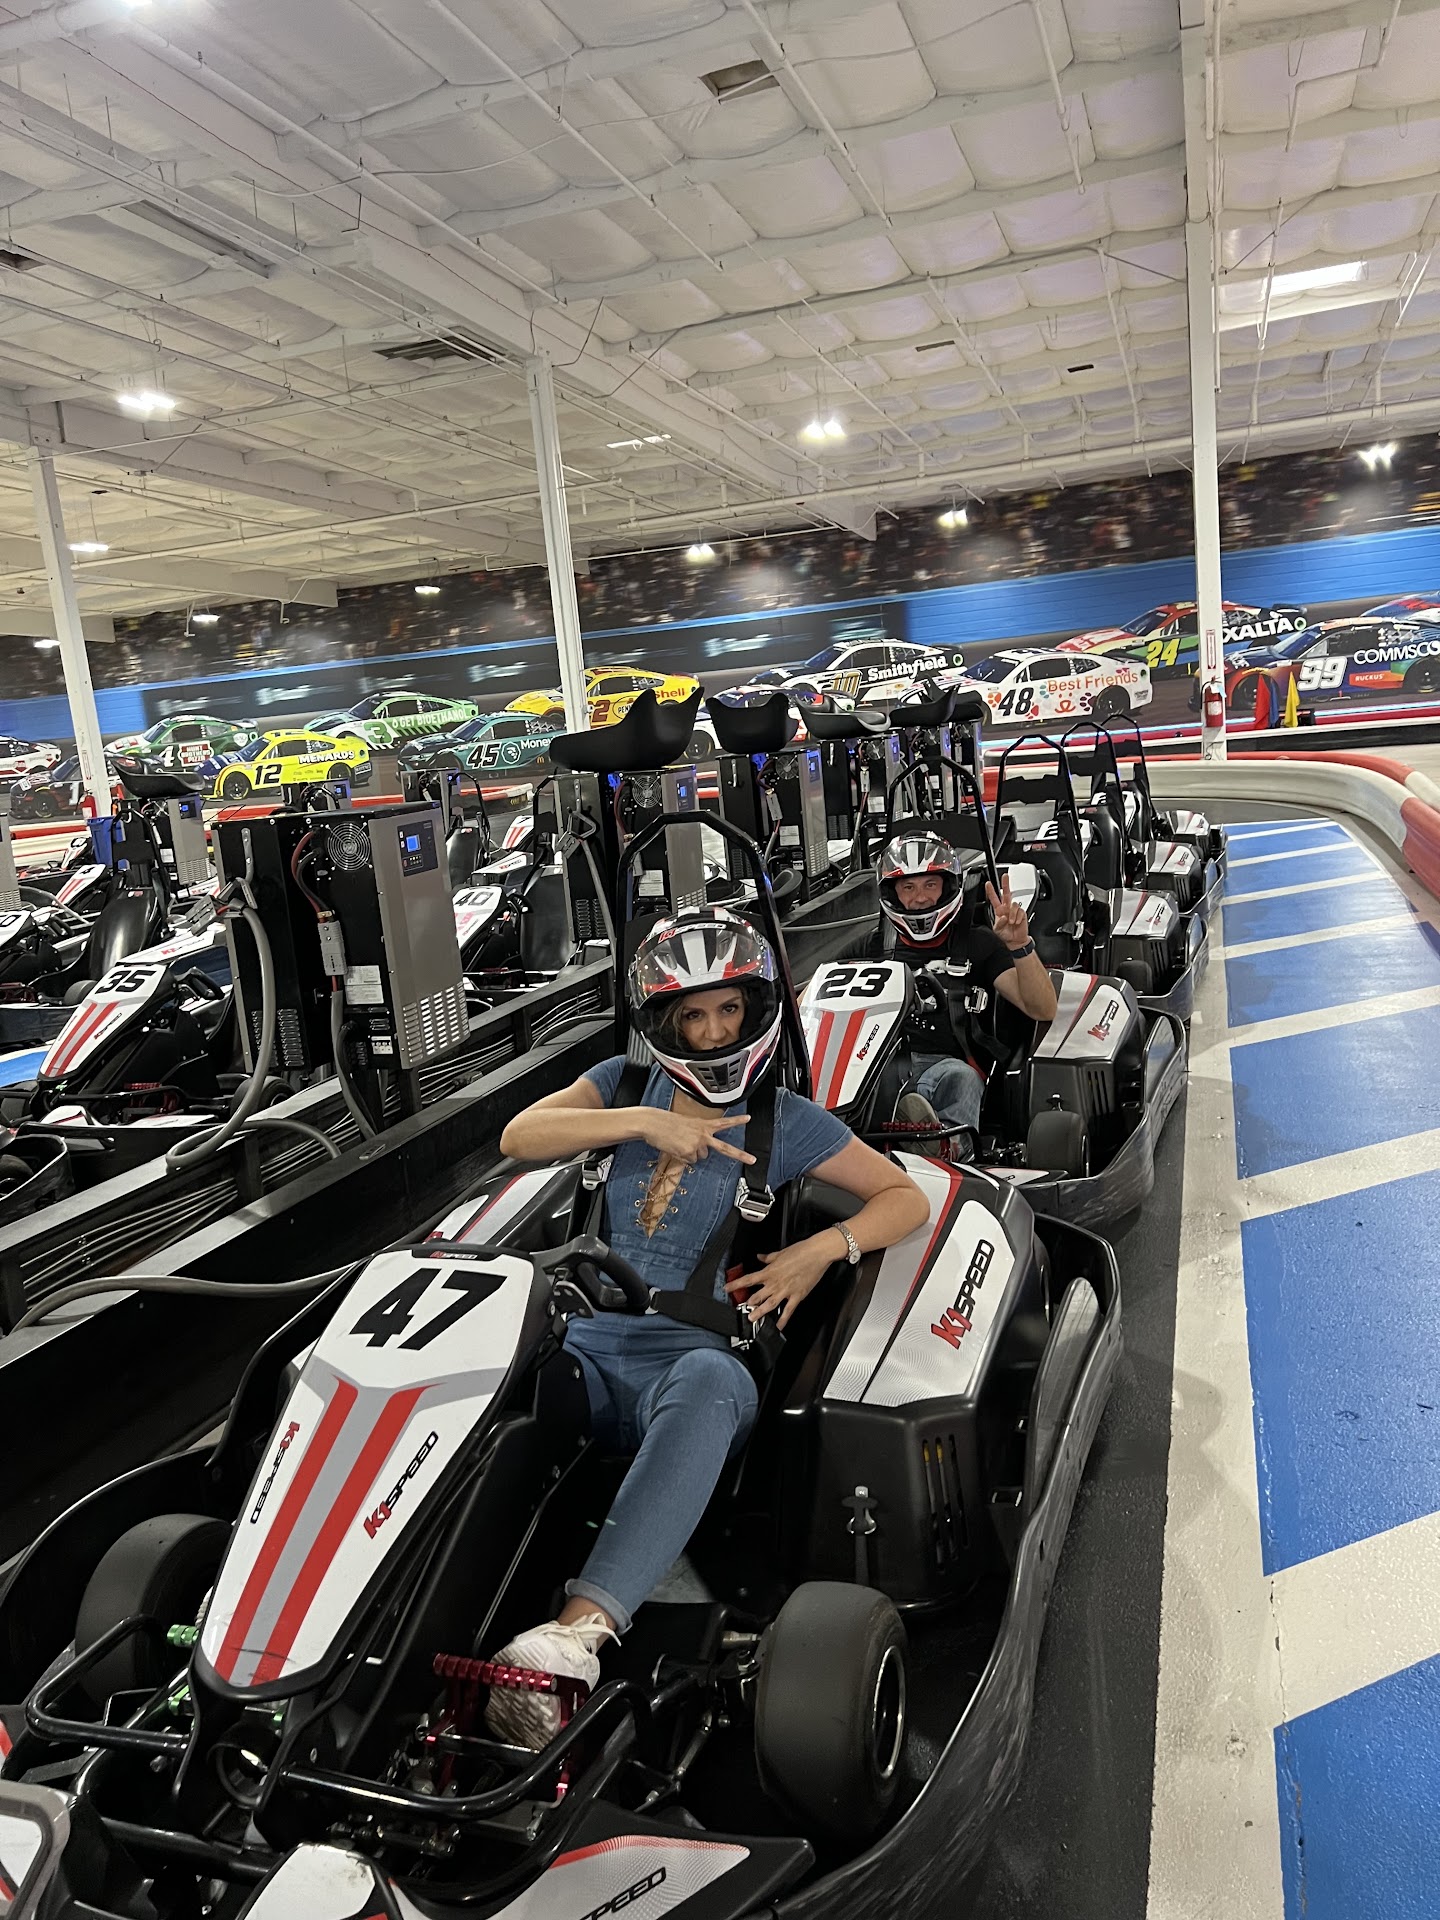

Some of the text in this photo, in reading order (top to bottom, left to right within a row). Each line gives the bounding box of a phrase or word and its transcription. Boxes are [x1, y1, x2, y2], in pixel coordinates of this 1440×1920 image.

[1222, 617, 1294, 643] XALTA
[1146, 639, 1180, 668] 24
[868, 655, 948, 682] Smithfield
[1048, 671, 1139, 692] Best Friends
[1297, 656, 1348, 691] 99
[655, 688, 685, 699] Shell
[998, 687, 1034, 716] 48
[400, 708, 470, 727] GET BIOETHANOL
[363, 721, 393, 744] 3
[159, 745, 175, 767] 4
[298, 750, 355, 764] MENARDS
[466, 741, 502, 769] 45
[255, 764, 282, 785] 12
[454, 891, 494, 907] 40
[94, 970, 157, 994] 35
[814, 968, 893, 1000] 23
[855, 1023, 880, 1061] K1SPEED
[931, 1239, 995, 1350] K1SPEED
[348, 1267, 508, 1351] 47
[363, 1431, 439, 1539] K1SPEED
[579, 1866, 667, 1920] PEED
